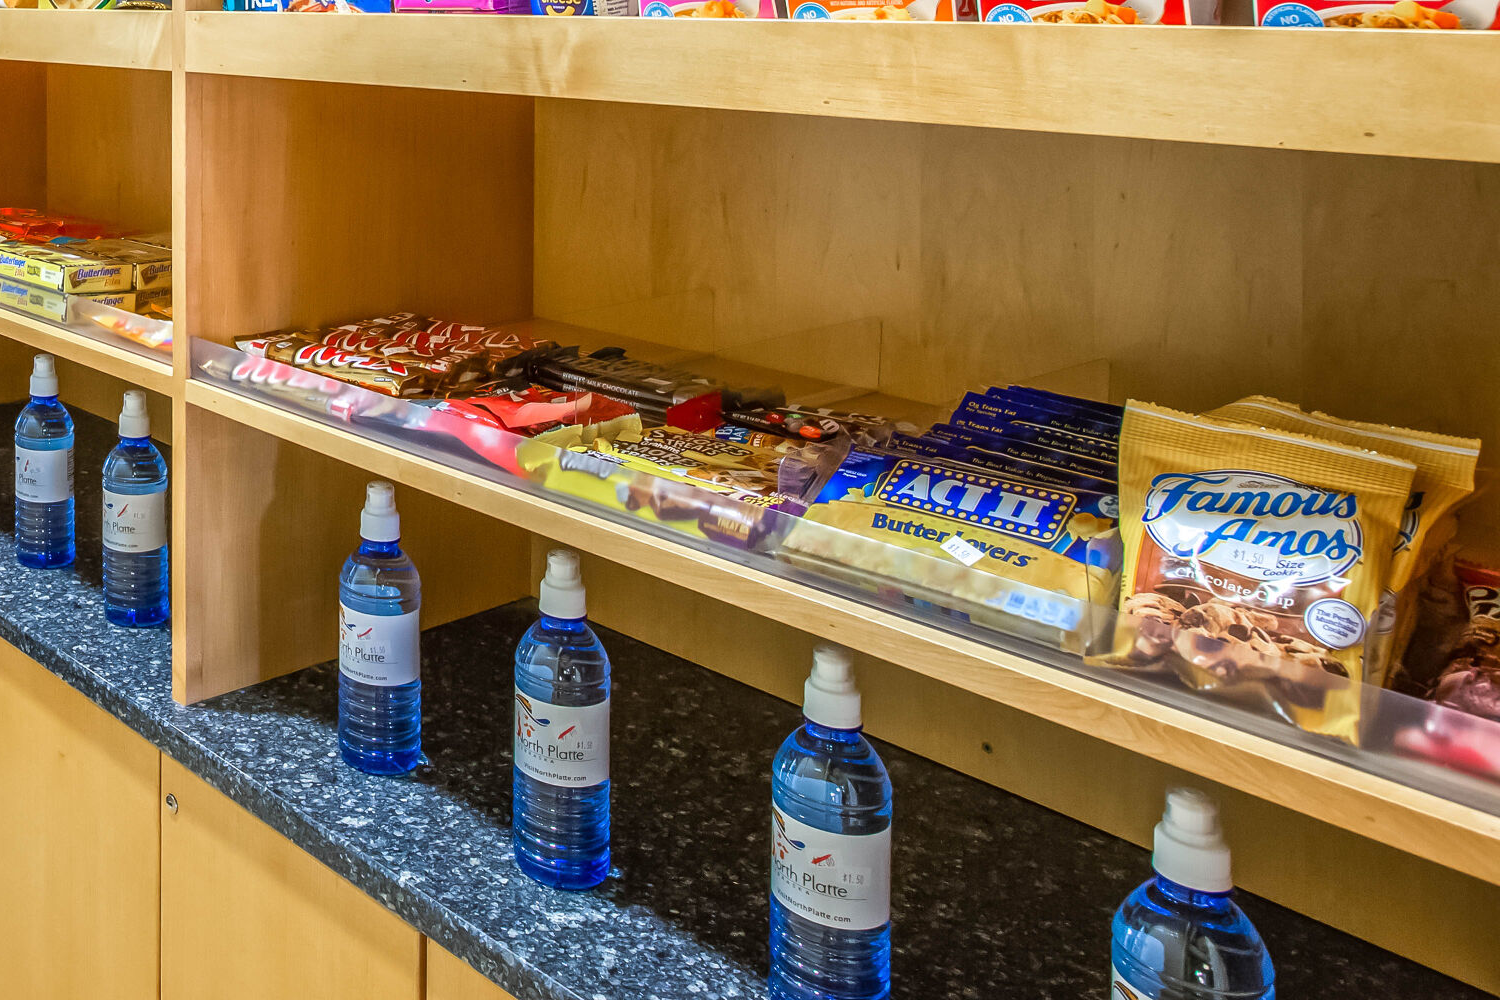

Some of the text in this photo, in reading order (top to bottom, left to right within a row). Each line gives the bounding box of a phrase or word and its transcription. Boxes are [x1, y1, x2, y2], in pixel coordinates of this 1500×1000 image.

[804, 10, 816, 18] NO
[999, 14, 1014, 22] NO
[1280, 14, 1299, 25] NO
[0, 254, 26, 268] Butterfinger
[77, 267, 121, 280] Butterfinger
[587, 380, 601, 388] MILK
[602, 384, 639, 396] CHOCOLATE
[982, 403, 1003, 413] Trans
[668, 439, 718, 455] TREATS
[19, 473, 37, 485] Platte
[897, 474, 1049, 527] ACT II
[1141, 473, 1358, 522] Famous
[113, 522, 135, 534] Platte
[872, 512, 949, 543] Butter
[1173, 519, 1361, 560] Amos
[1233, 548, 1263, 564] $1.50
[1277, 560, 1305, 569] Size
[1256, 590, 1294, 609] Cip
[1317, 609, 1330, 617] The
[355, 647, 385, 664] Platte
[518, 735, 584, 762] North Platte
[803, 873, 848, 898] Platte
[777, 889, 851, 923] VisitNorthPlatte.com
